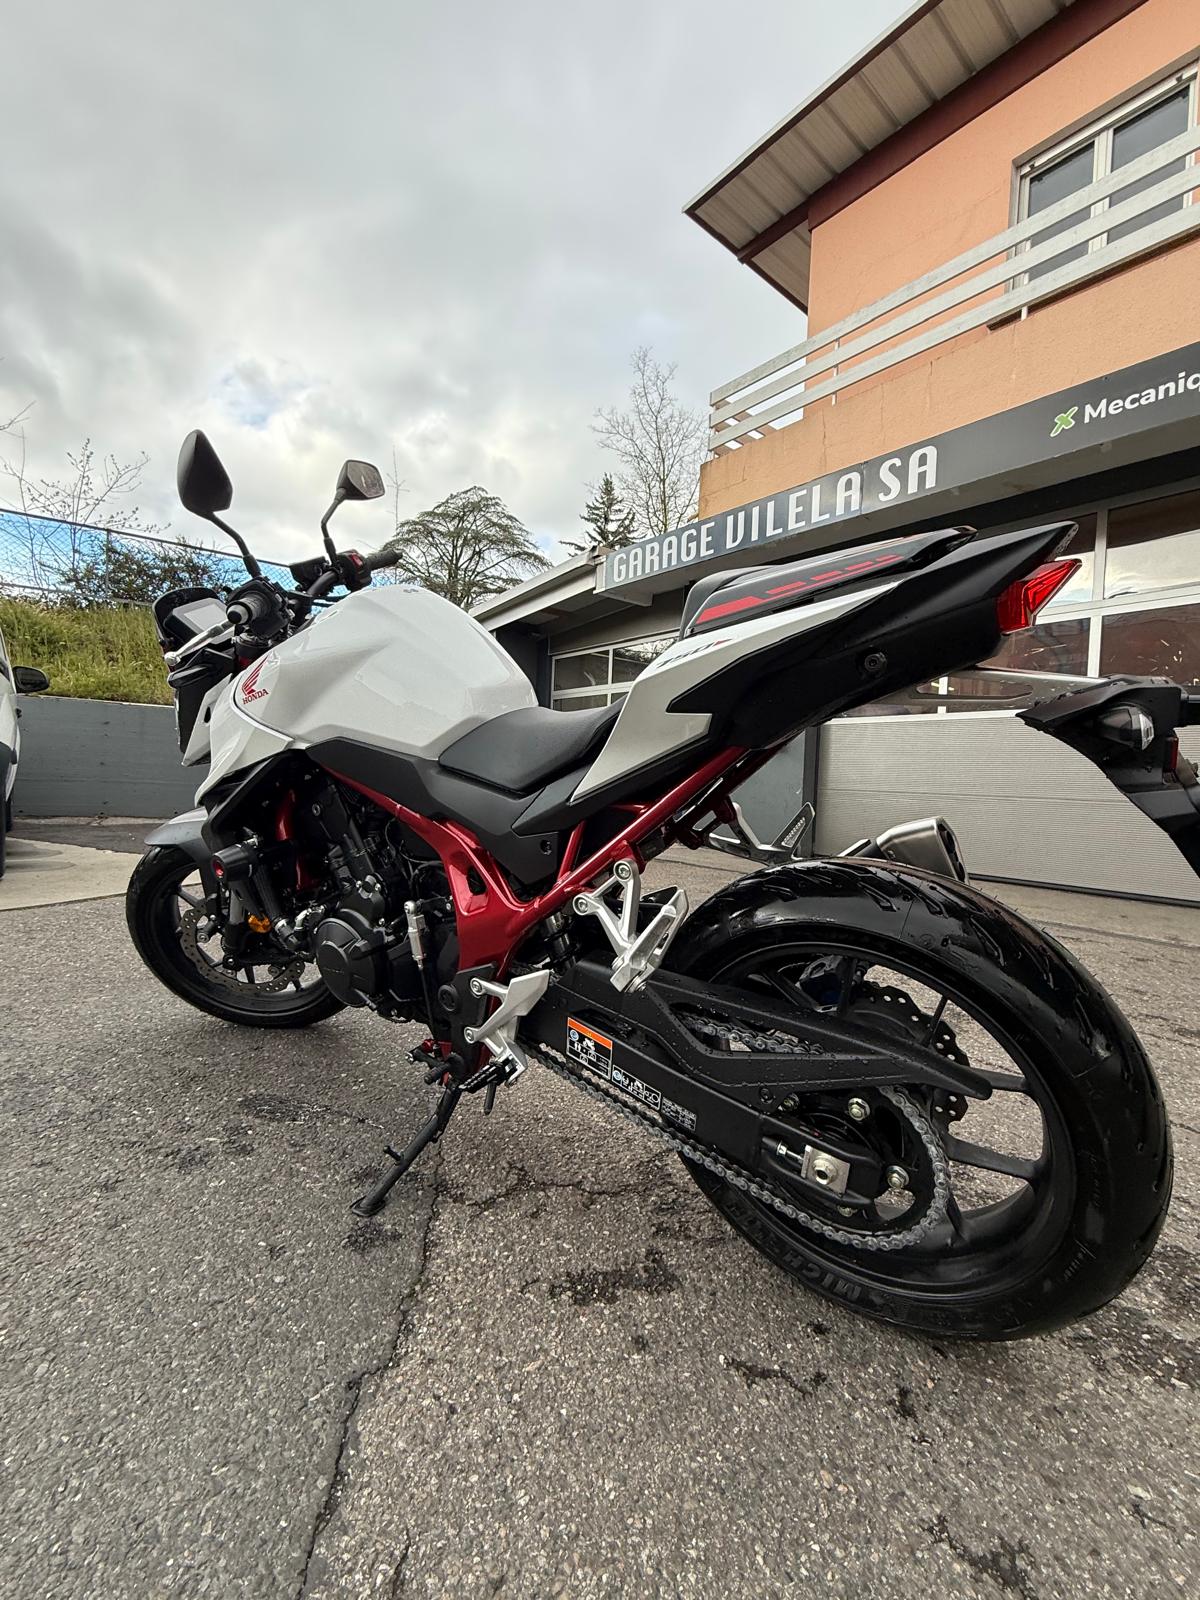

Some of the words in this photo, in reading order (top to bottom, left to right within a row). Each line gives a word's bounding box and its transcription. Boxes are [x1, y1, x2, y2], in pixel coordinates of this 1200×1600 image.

[613, 521, 715, 583] GARAGE
[725, 471, 861, 549] VILELA
[878, 445, 938, 502] SA
[242, 688, 269, 705] HONDA
